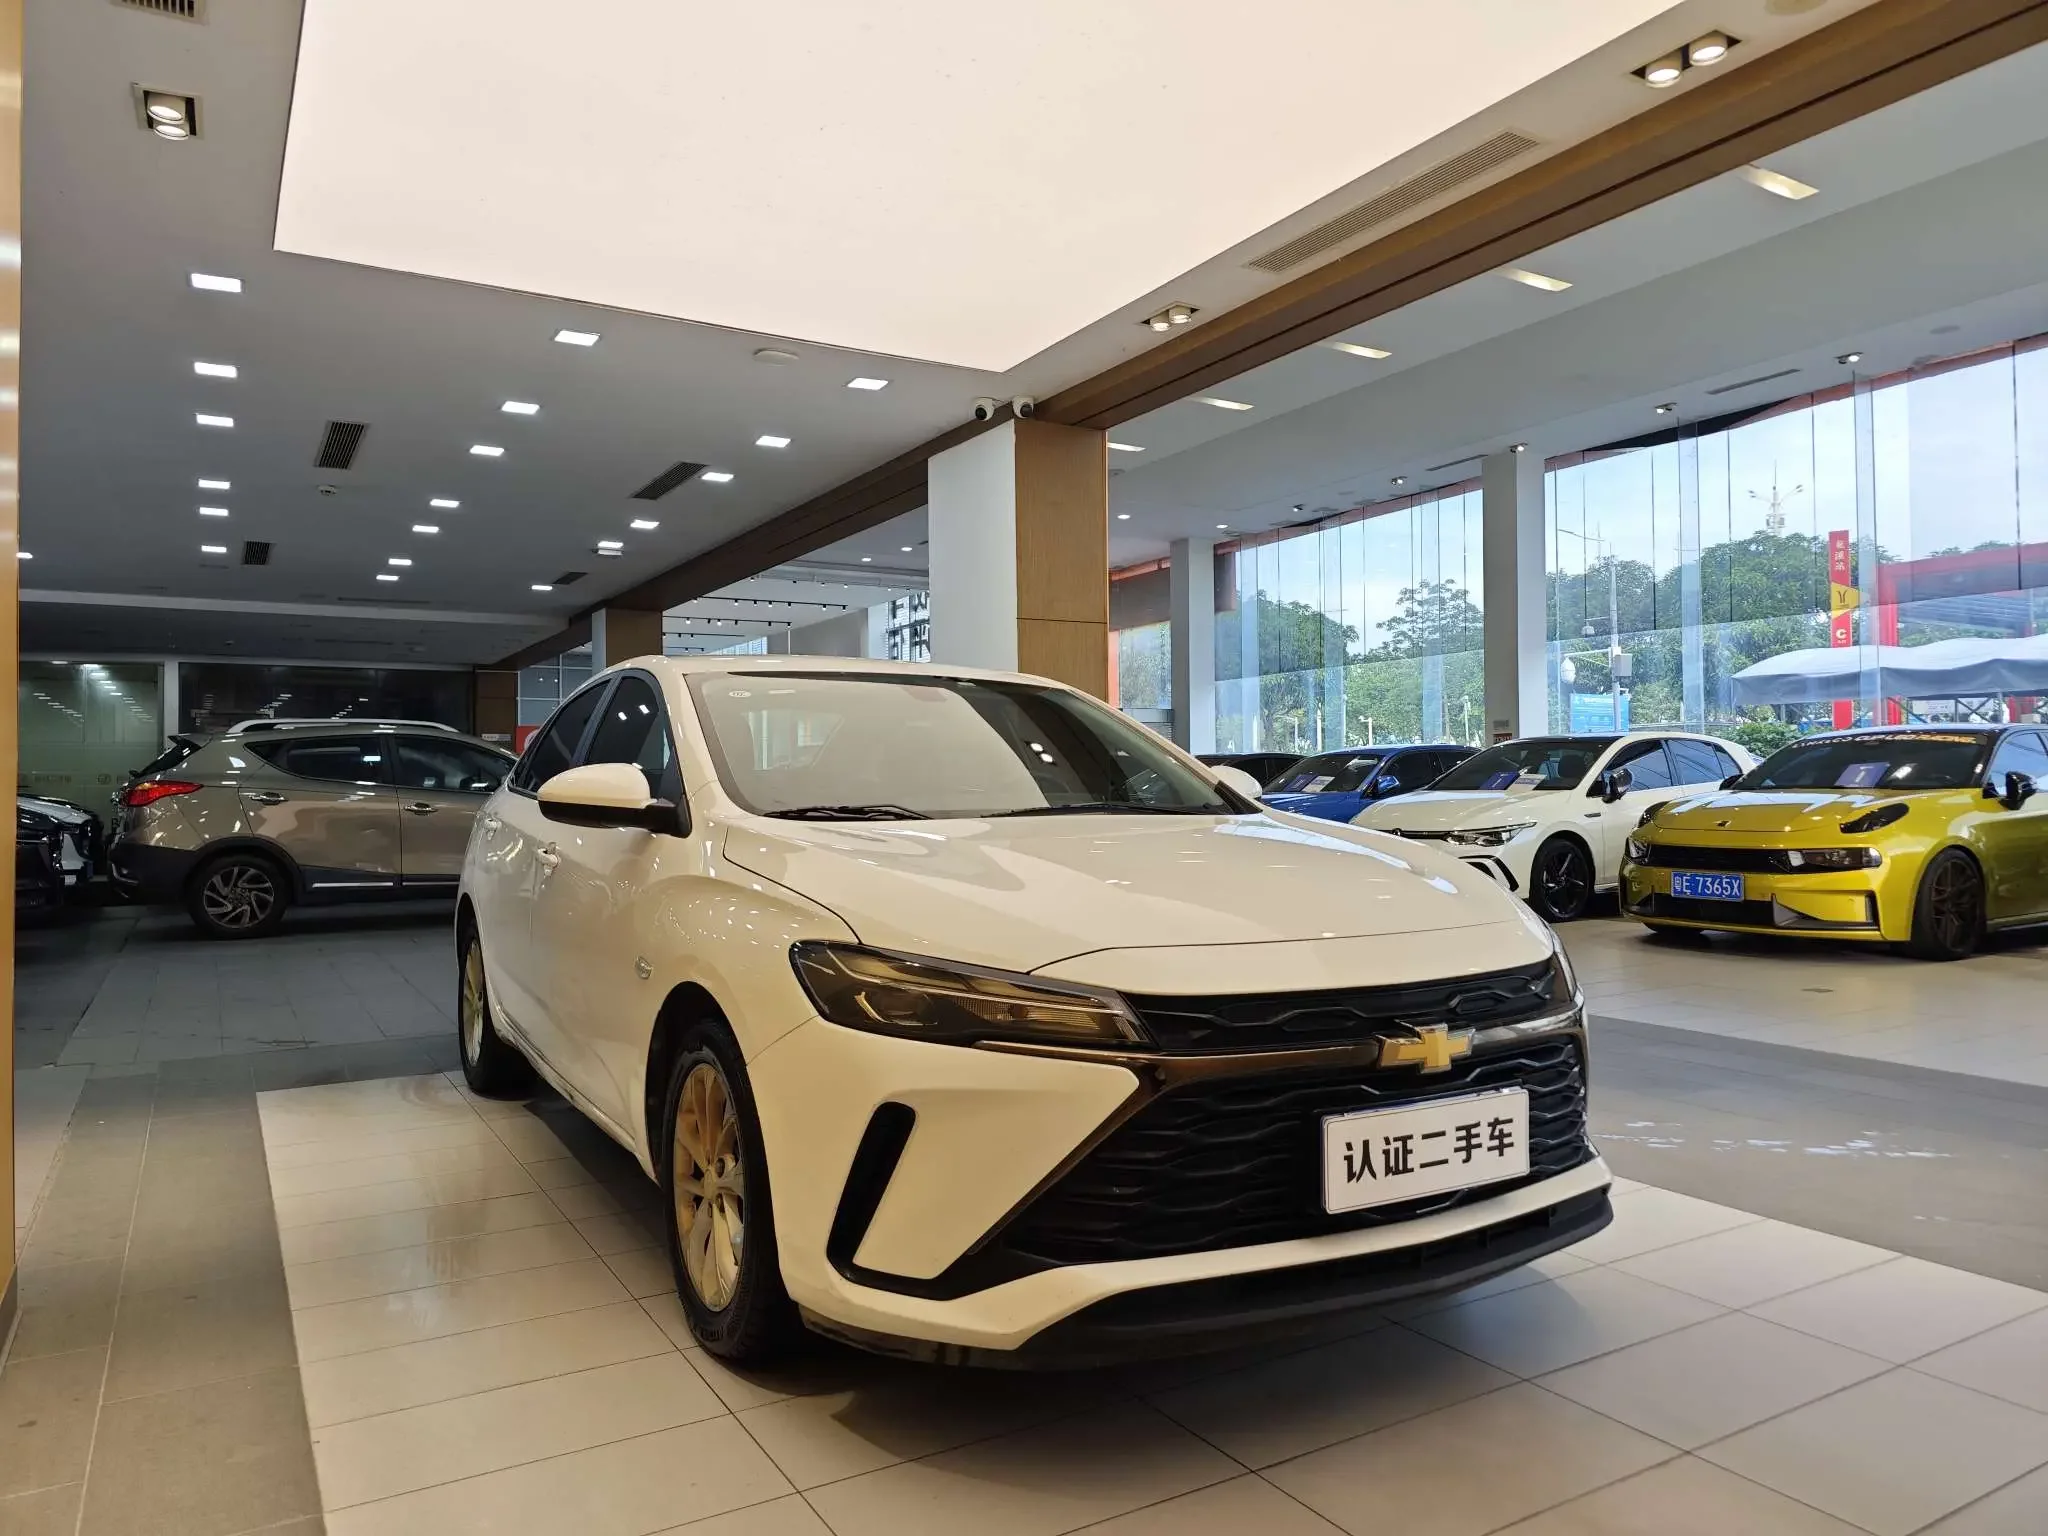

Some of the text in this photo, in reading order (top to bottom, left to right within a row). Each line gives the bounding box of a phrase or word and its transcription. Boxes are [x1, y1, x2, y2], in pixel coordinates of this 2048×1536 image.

[1343, 1117, 1515, 1184] 认证二手车
